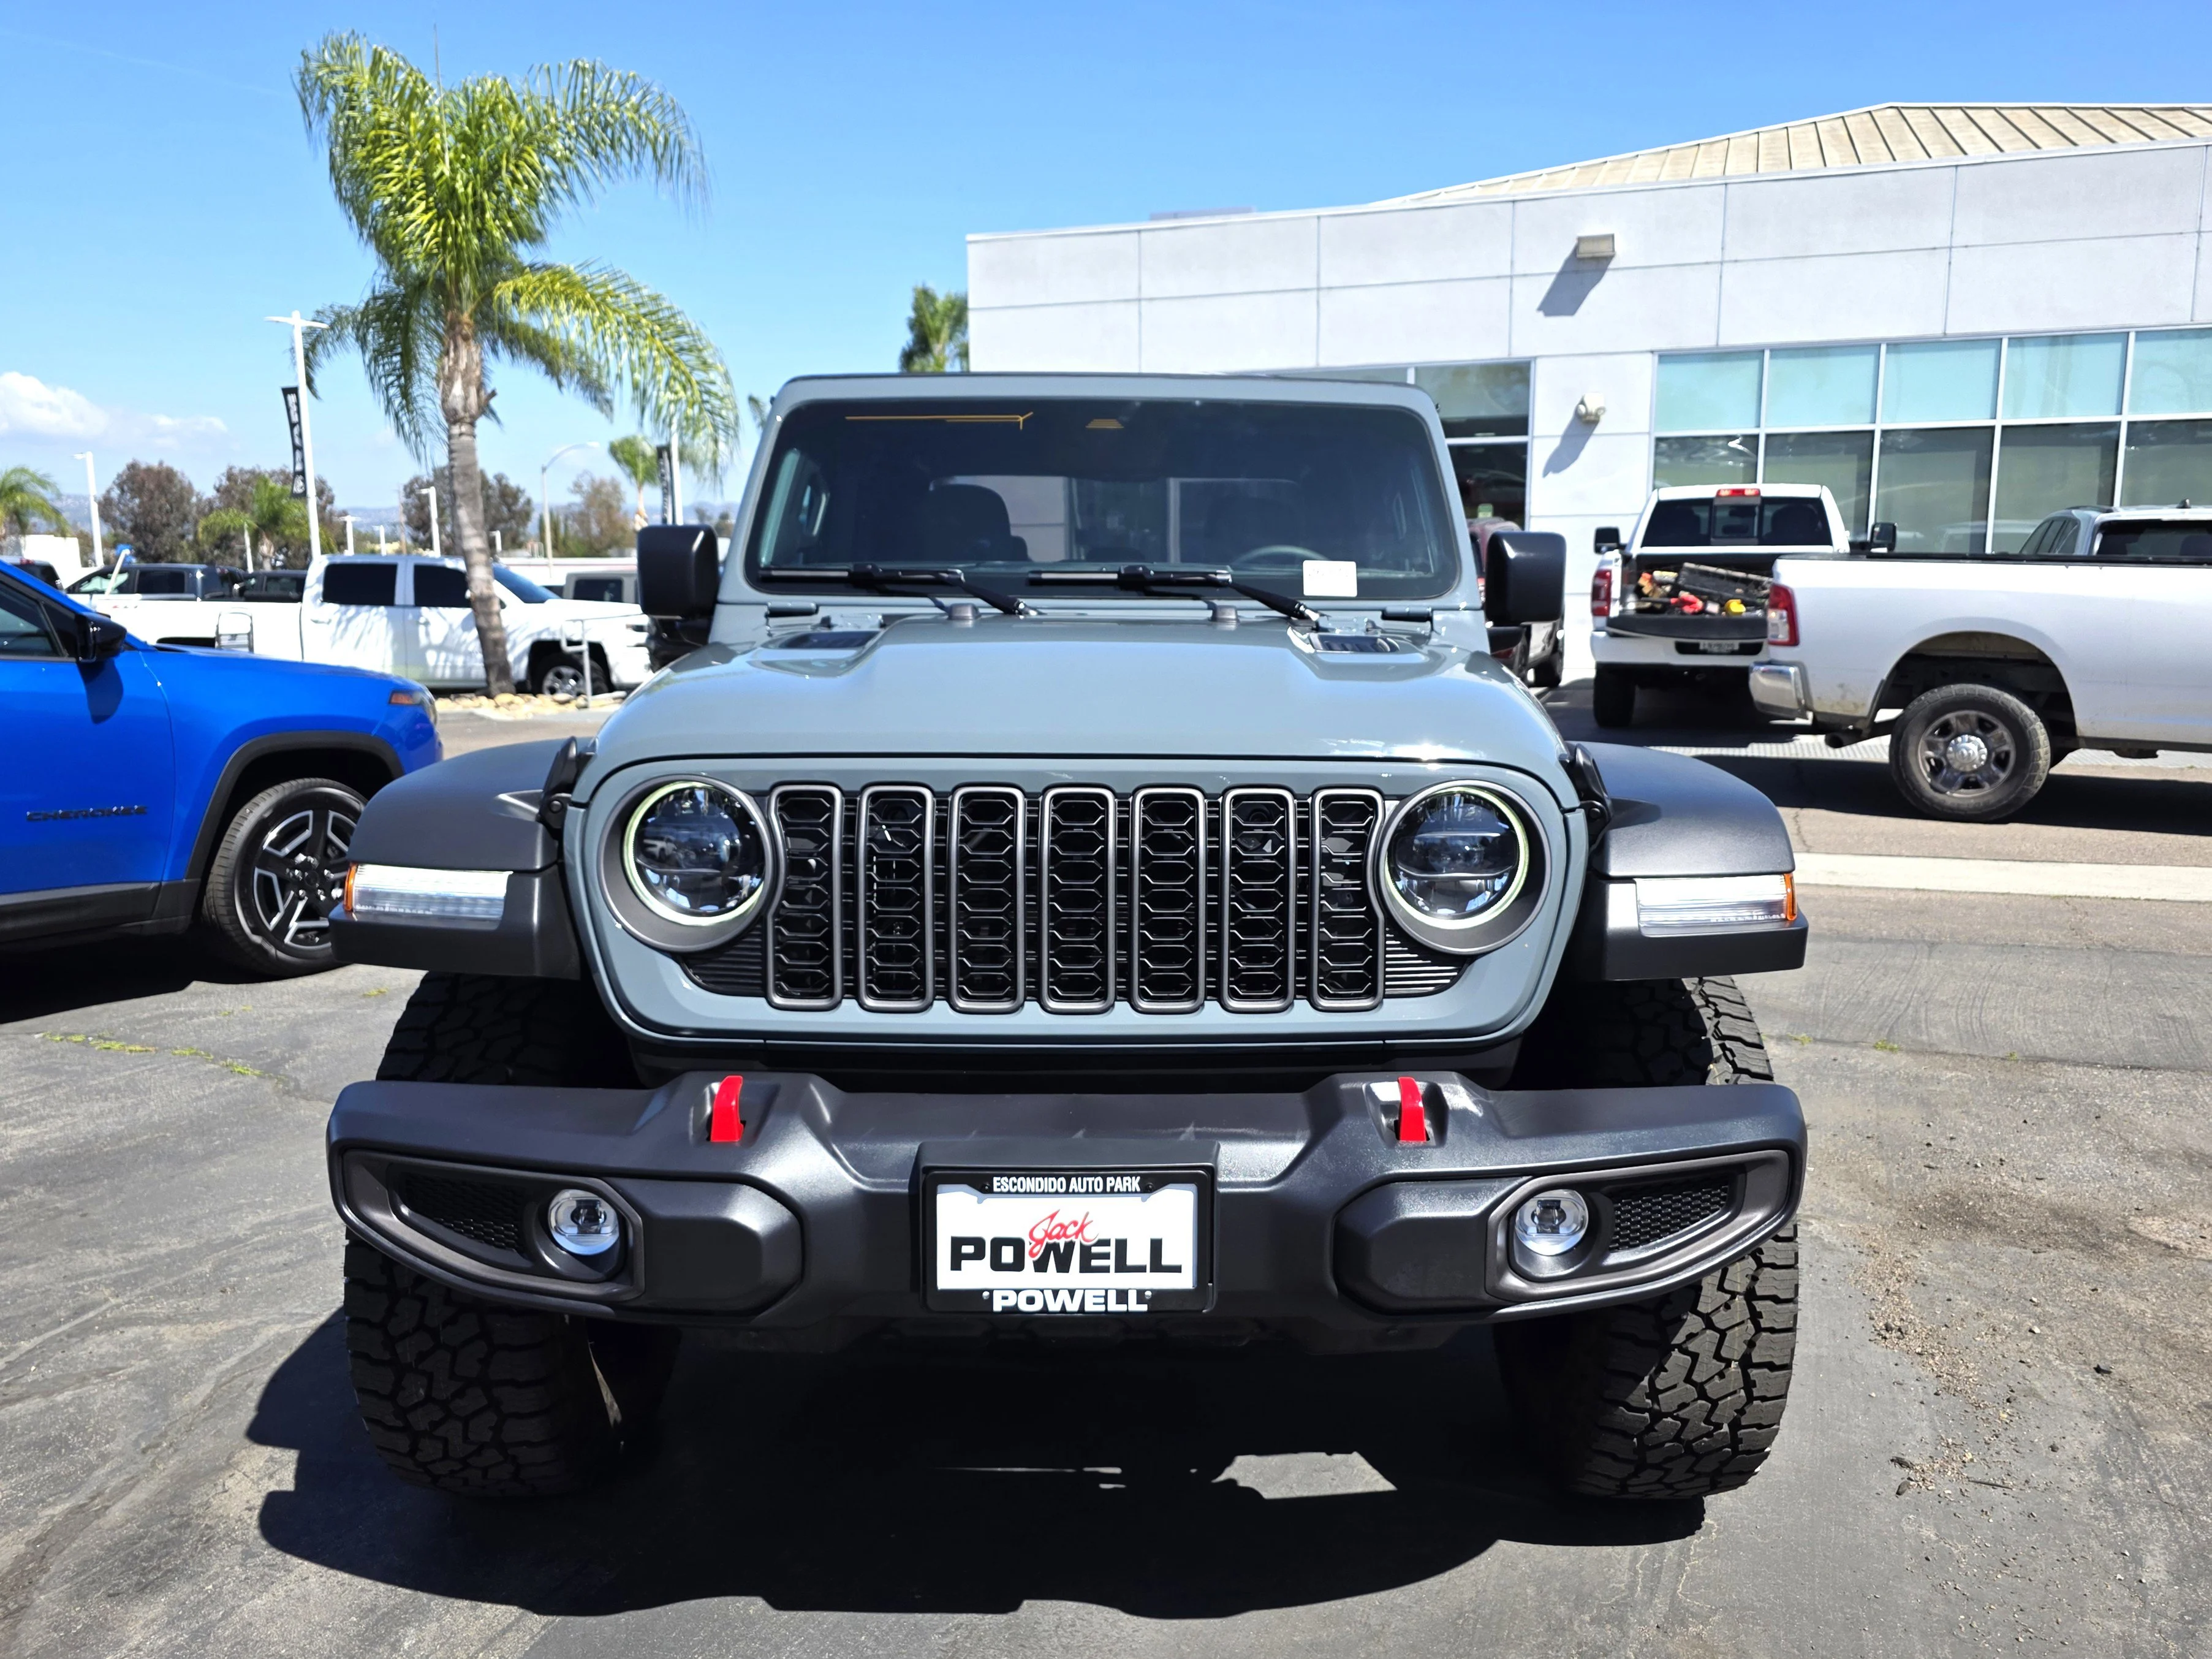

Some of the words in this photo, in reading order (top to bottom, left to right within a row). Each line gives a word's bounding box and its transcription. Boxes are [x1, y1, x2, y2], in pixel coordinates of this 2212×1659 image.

[26, 805, 147, 821] CHEROKEE
[993, 1177, 1066, 1193] ESCONDIDO
[1069, 1177, 1103, 1193] AUTO
[1106, 1176, 1140, 1192] PARK
[1028, 1209, 1099, 1258] Jack
[950, 1236, 1182, 1273] POWELL
[993, 1289, 1148, 1312] POWELL
